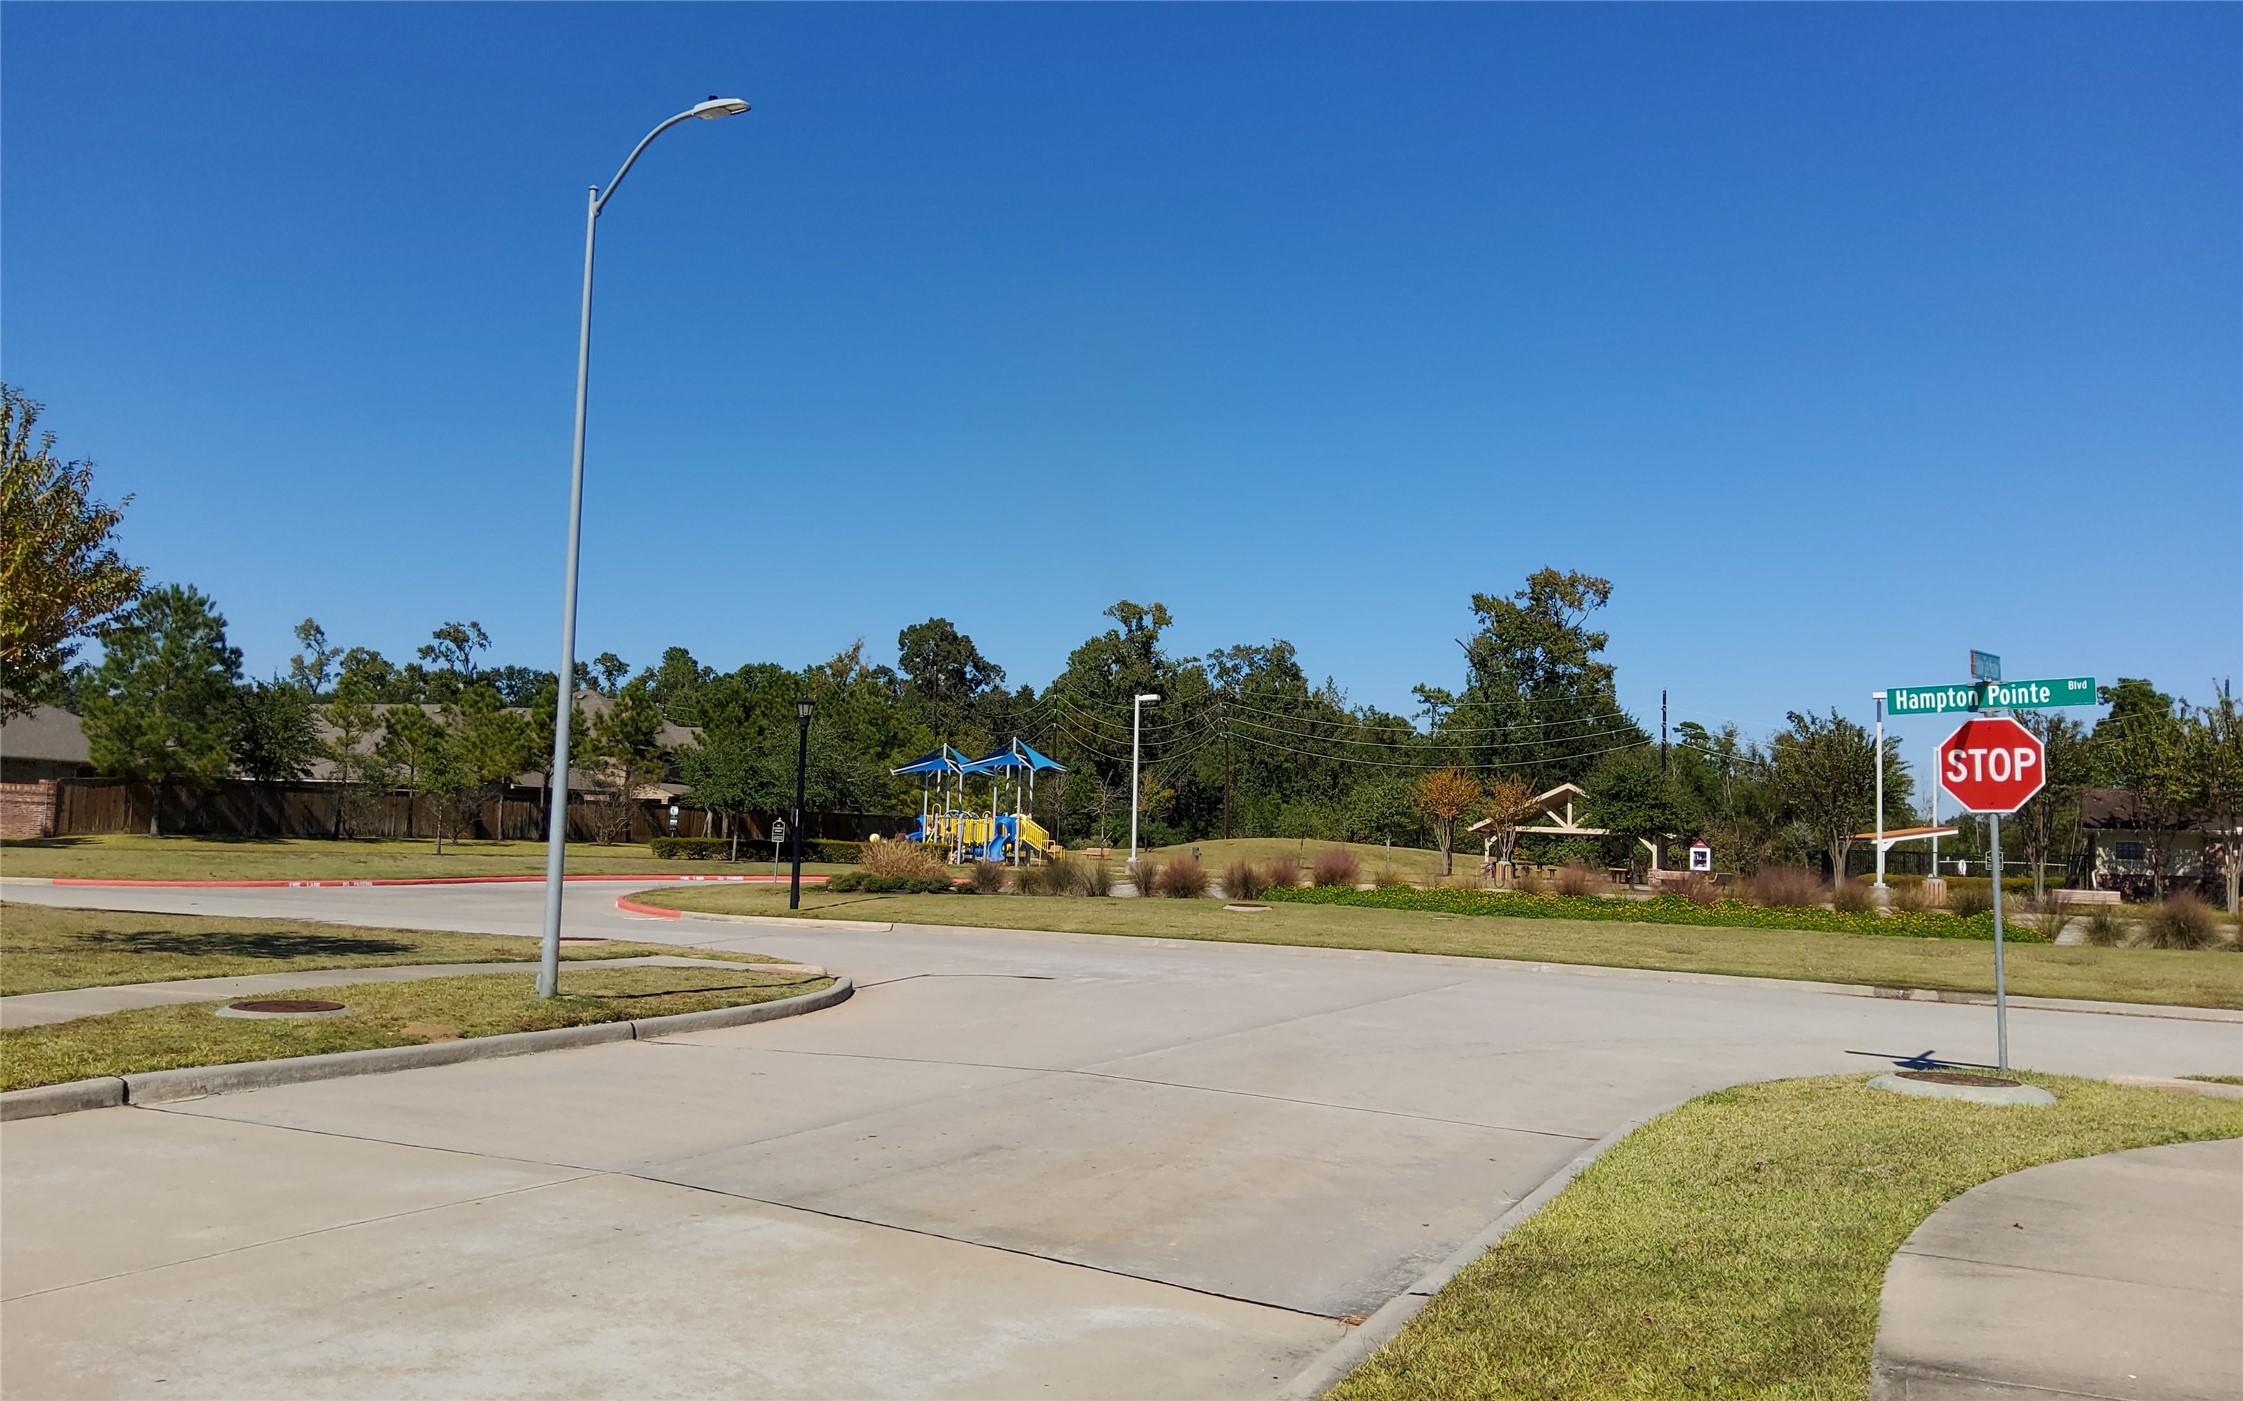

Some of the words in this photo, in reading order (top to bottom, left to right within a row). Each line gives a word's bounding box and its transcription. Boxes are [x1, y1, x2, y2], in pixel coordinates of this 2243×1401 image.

[1895, 687, 1979, 713] Hampton
[1987, 683, 2051, 706] Pointe
[2067, 680, 2088, 690] Blvd
[1946, 747, 2036, 783] STOP
